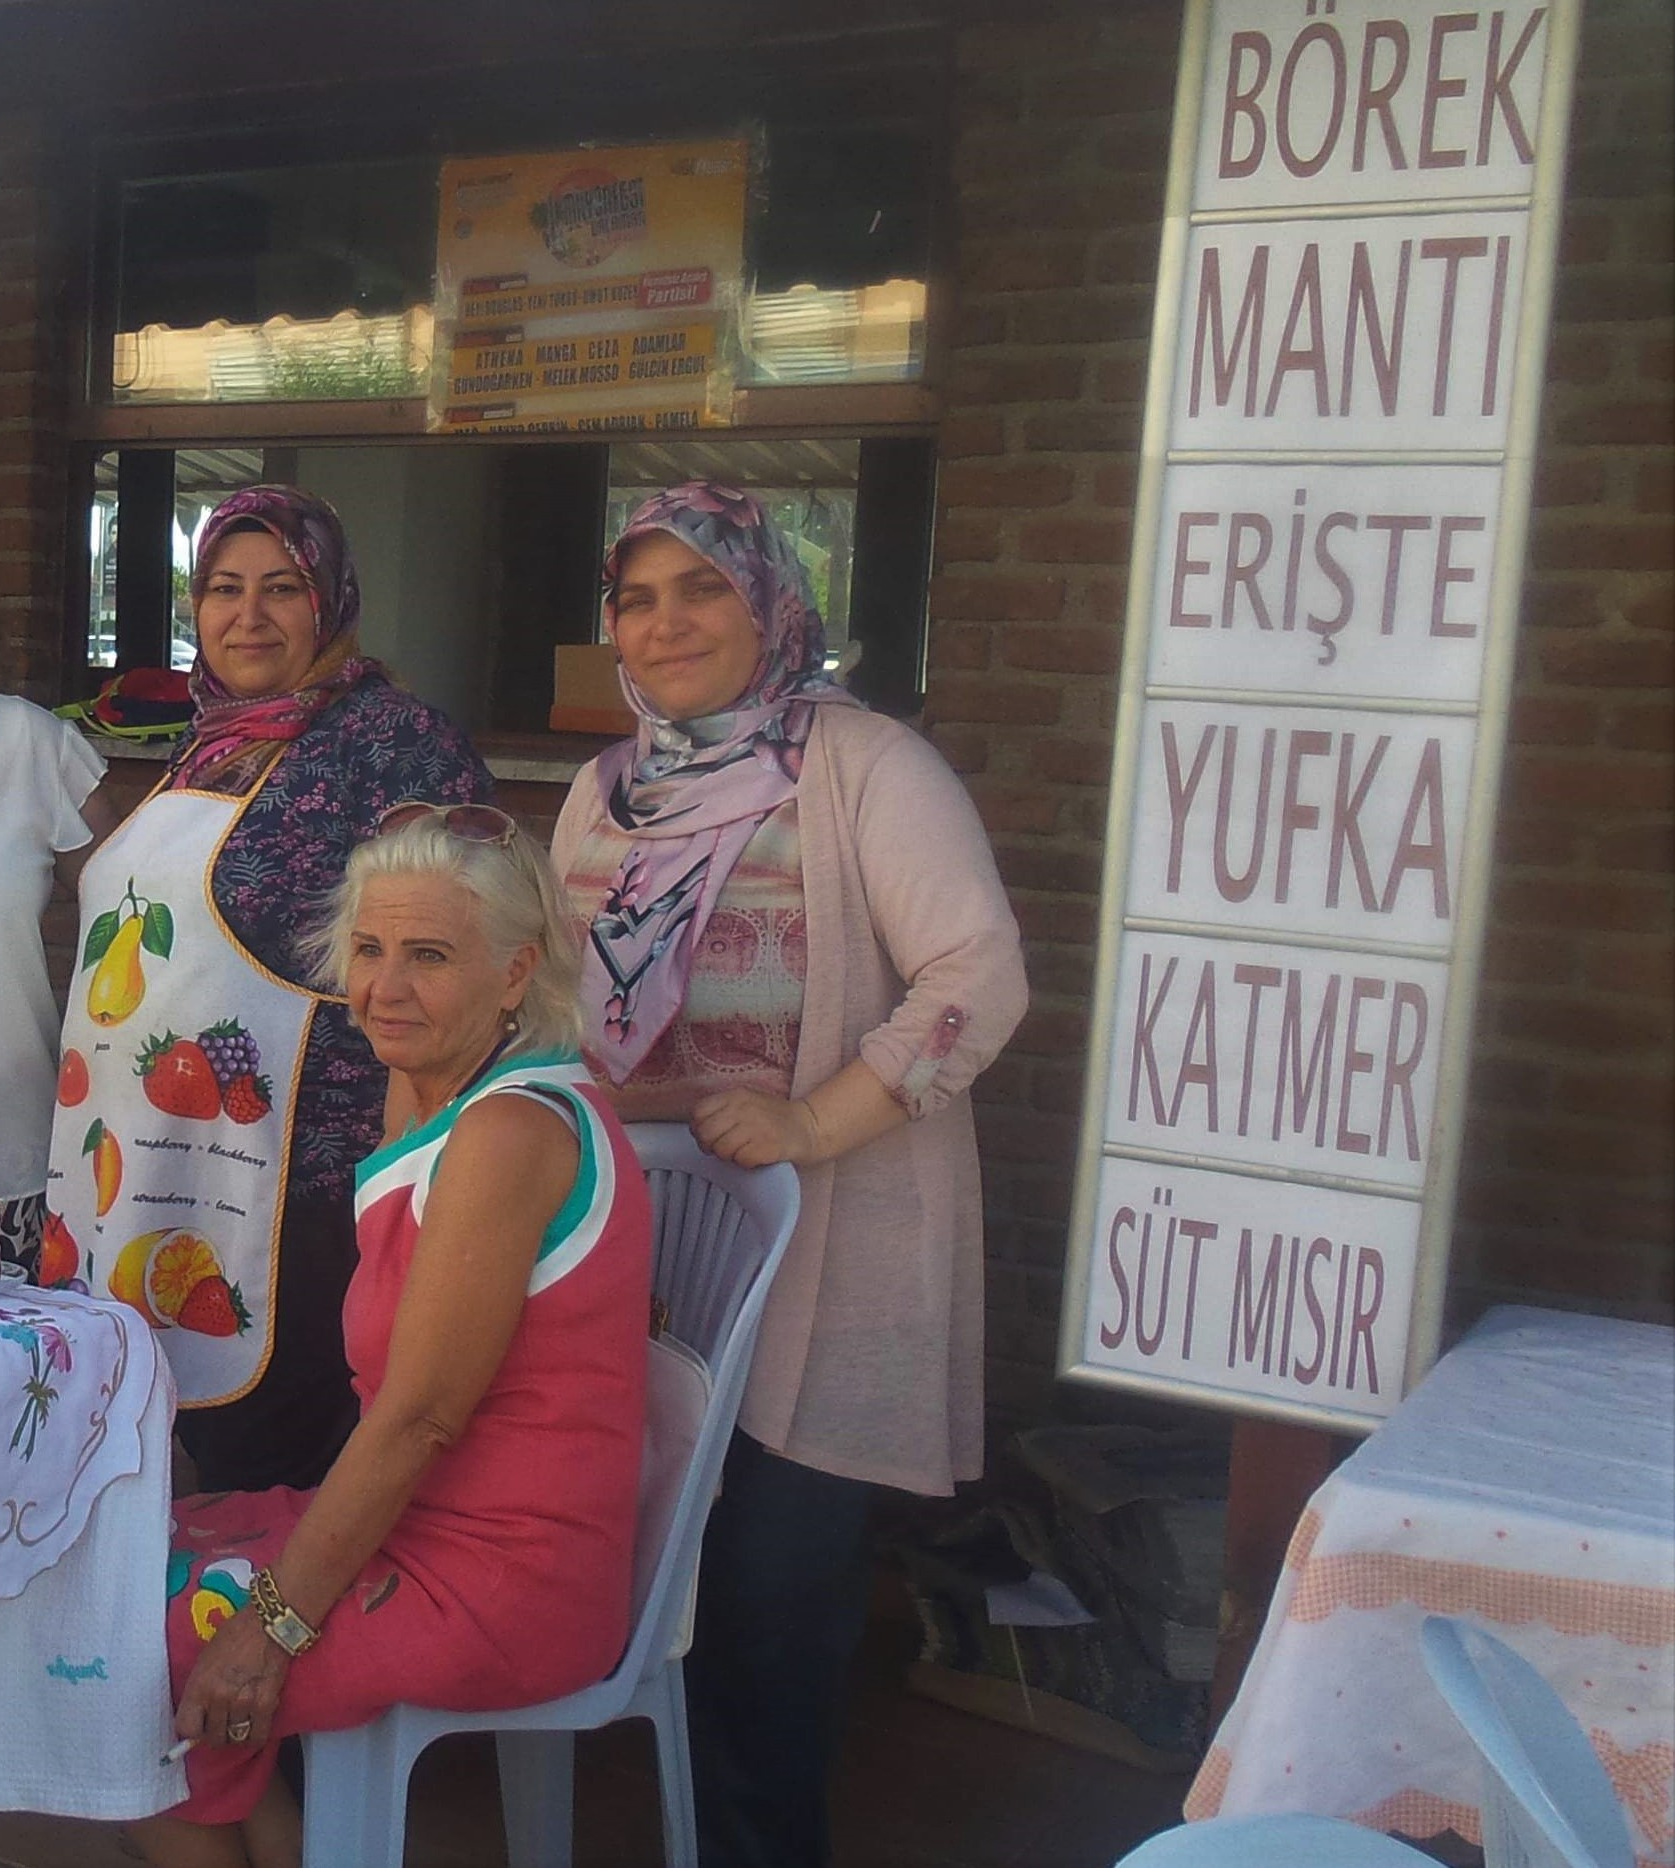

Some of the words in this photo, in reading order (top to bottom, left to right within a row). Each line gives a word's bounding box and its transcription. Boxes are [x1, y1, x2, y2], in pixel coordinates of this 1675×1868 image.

[1219, 0, 1547, 179] BÖREK
[476, 349, 523, 369] ATHENA
[535, 343, 577, 364] MANGA
[588, 339, 619, 359] CEZA
[632, 333, 686, 355] ADAMLAR
[1189, 236, 1510, 418] MANTI
[1169, 489, 1485, 667] ERİŞTE
[1161, 721, 1450, 919] YUFKA
[1127, 953, 1429, 1161] KATMER
[207, 1141, 267, 1169] blackberry
[215, 1200, 246, 1217] lemon
[1101, 1187, 1218, 1360] SÜT
[1228, 1228, 1385, 1394] MISIR
